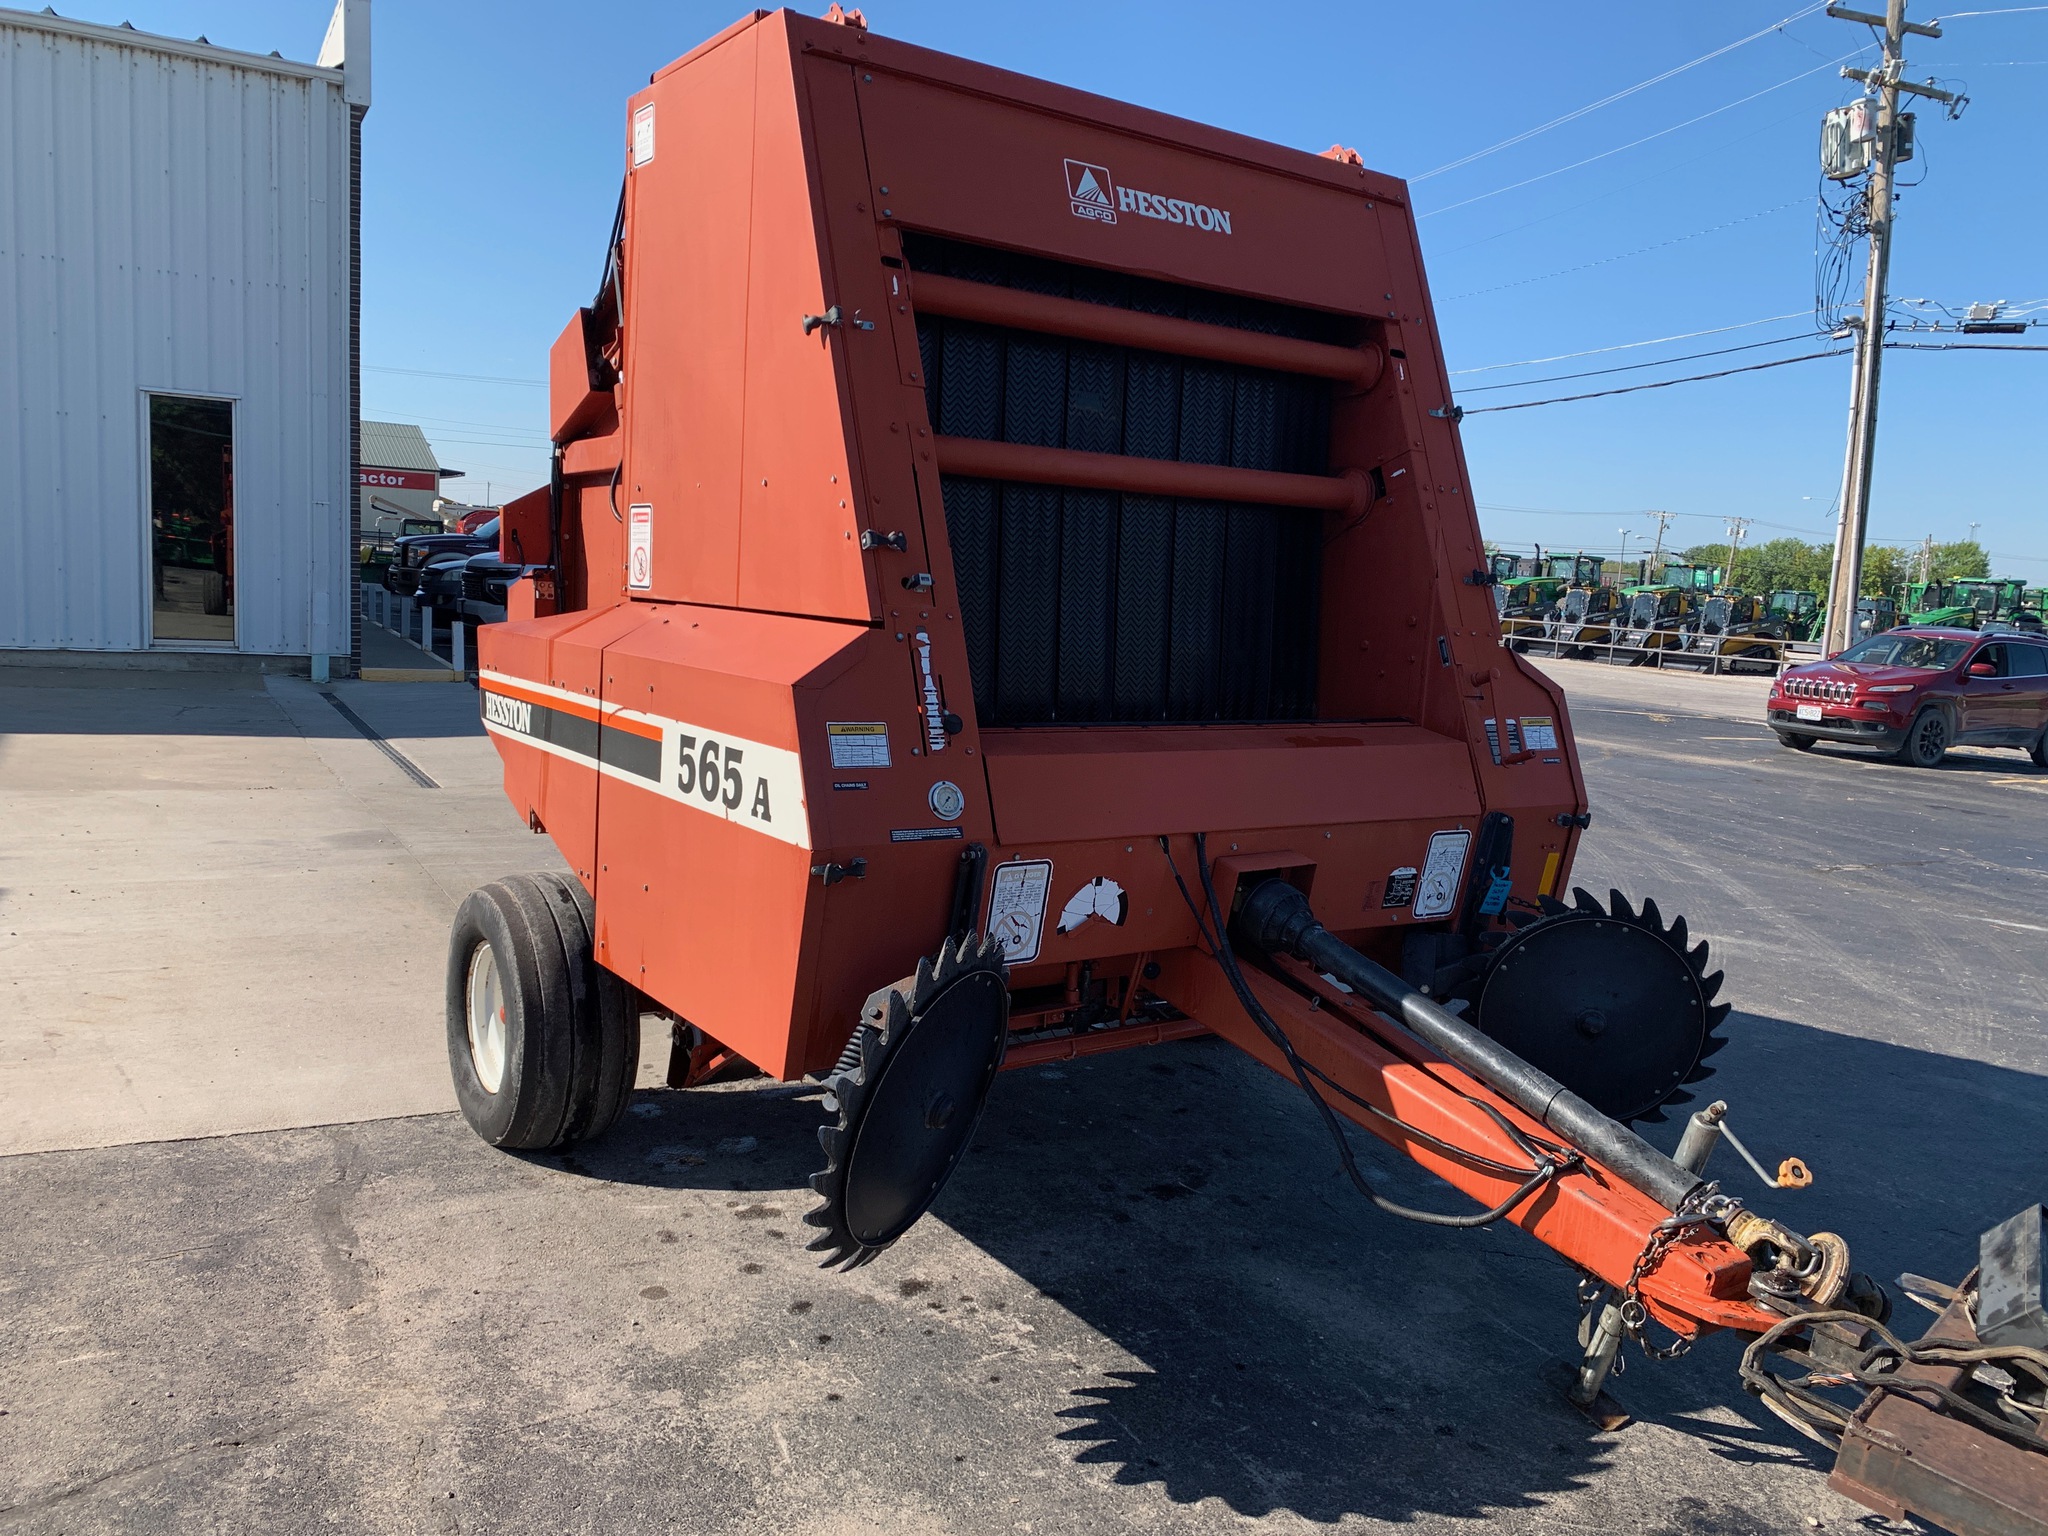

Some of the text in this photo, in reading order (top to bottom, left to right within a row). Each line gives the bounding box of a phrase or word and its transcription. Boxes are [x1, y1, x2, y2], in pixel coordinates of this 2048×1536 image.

[1077, 206, 1112, 221] AGCO
[1116, 185, 1232, 235] HESSTON
[485, 691, 532, 734] HESSTON
[678, 734, 772, 823] 565 A
